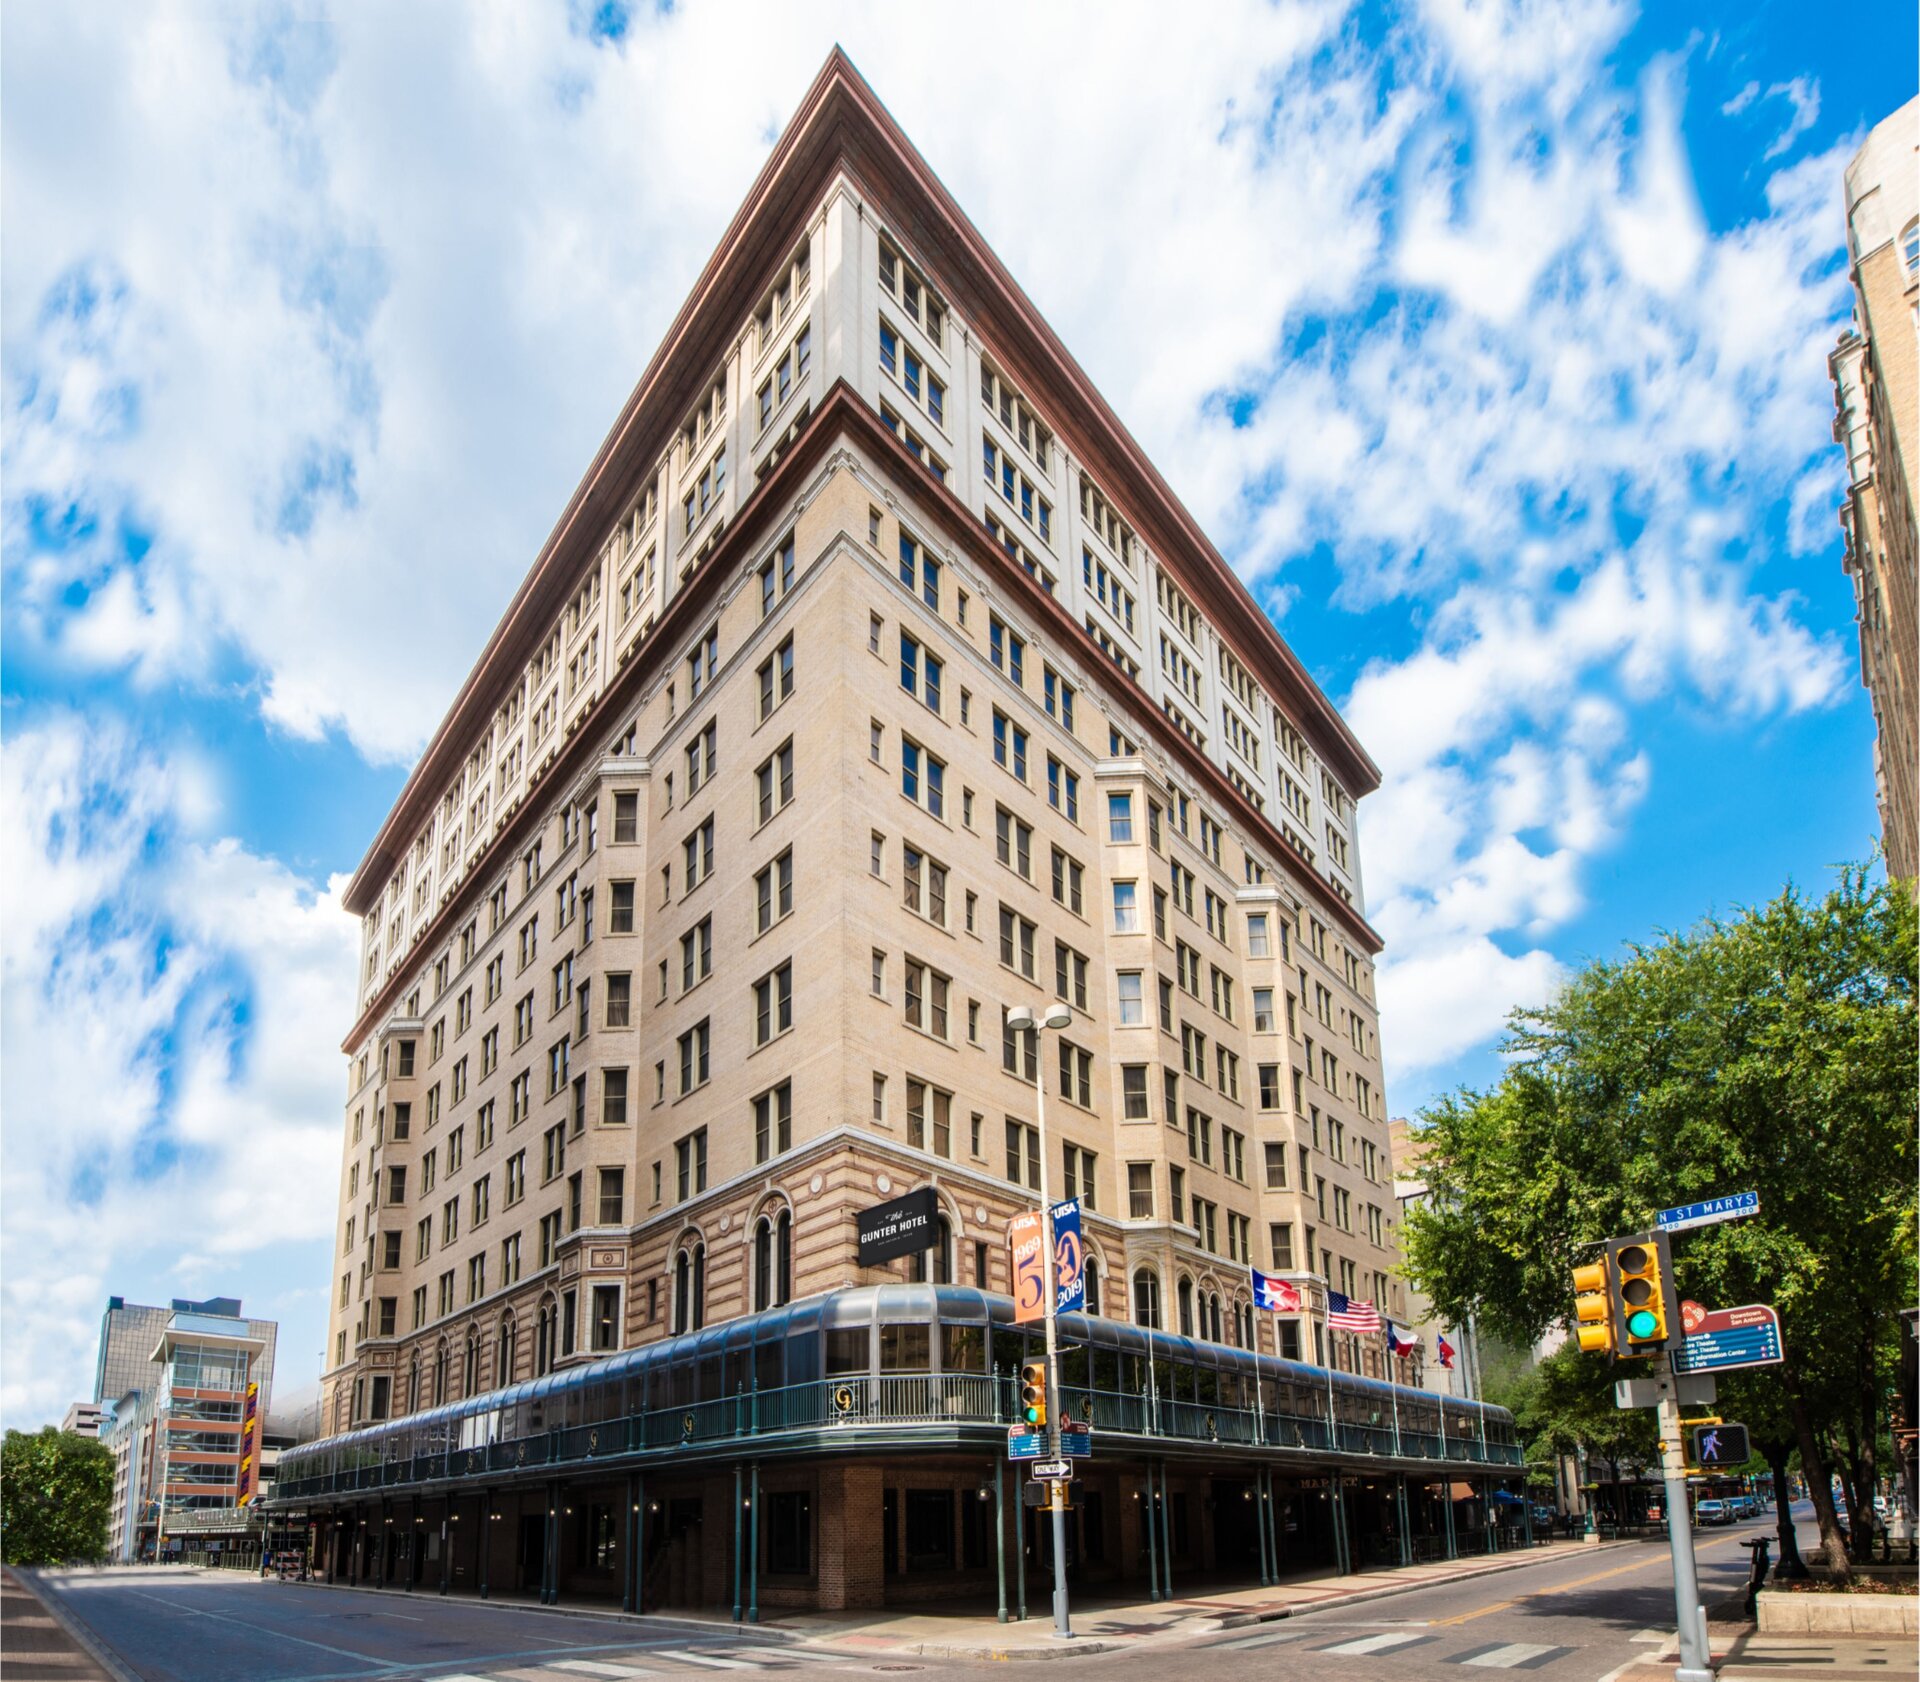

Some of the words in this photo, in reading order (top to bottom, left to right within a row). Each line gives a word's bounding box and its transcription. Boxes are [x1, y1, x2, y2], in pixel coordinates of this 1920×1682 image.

[1054, 1202, 1077, 1219] UTSA
[1660, 1212, 1668, 1224] N
[1676, 1206, 1694, 1220] ST
[1703, 1194, 1754, 1215] MARYS
[1735, 1207, 1754, 1216] 200
[861, 1224, 897, 1244] GUNTER
[900, 1215, 928, 1231] HOTEL
[1014, 1215, 1038, 1230] UTSA
[1014, 1235, 1041, 1263] 1969
[1057, 1279, 1083, 1309] 2019
[1730, 1310, 1761, 1320] Downtown
[1731, 1318, 1742, 1326] San
[1743, 1315, 1766, 1324] Antonio
[1728, 1349, 1746, 1357] Center
[1037, 1466, 1047, 1474] ONE
